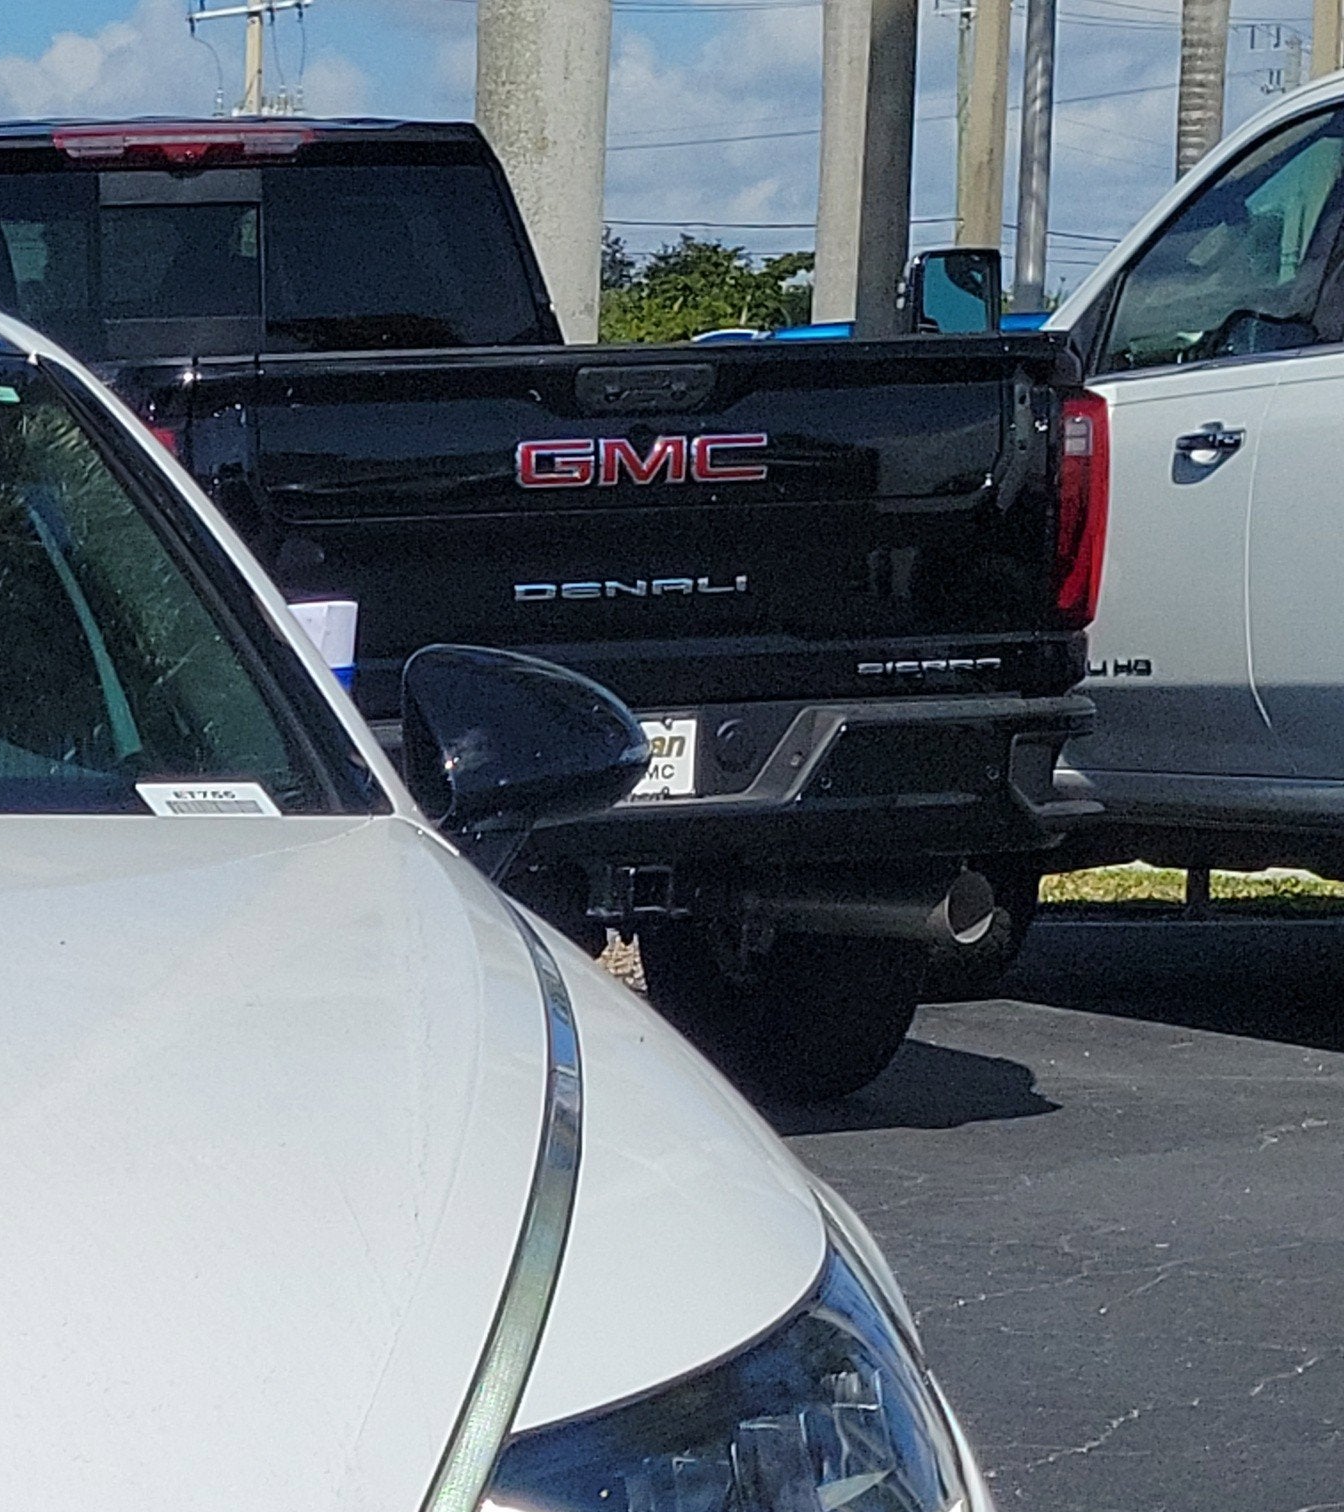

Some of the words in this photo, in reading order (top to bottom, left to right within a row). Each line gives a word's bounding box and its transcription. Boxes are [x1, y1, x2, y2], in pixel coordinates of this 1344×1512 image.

[516, 433, 767, 488] GMC
[514, 575, 747, 600] DENALI
[857, 657, 1002, 679] SIERRA
[1113, 659, 1152, 676] HD
[650, 735, 686, 758] an
[646, 764, 675, 780] MC
